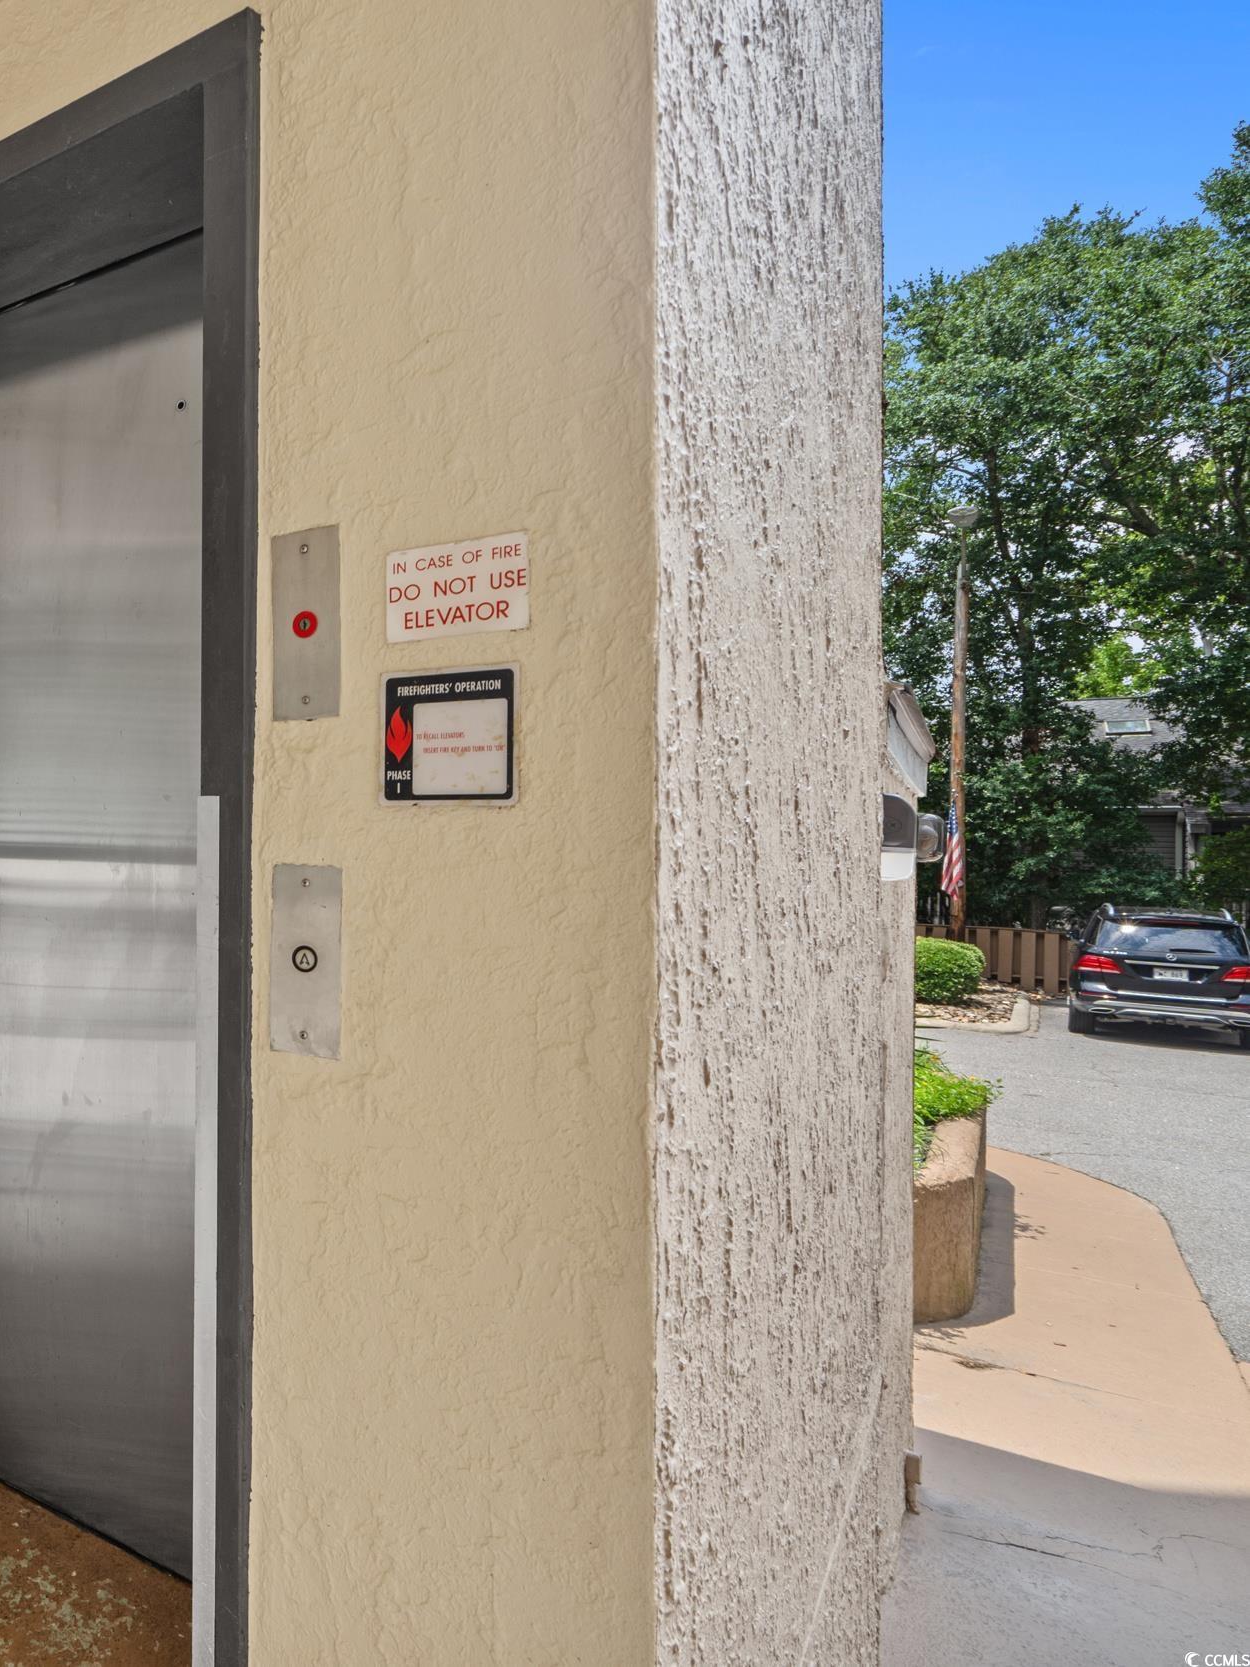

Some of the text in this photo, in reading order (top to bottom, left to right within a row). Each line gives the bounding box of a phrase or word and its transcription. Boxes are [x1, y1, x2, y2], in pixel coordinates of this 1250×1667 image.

[392, 543, 522, 575] IN CASE OF FIRE
[389, 568, 527, 603] DO NOT USE
[404, 600, 509, 630] ELEVATOR
[397, 679, 502, 697] FIREFIGHTERS' OPERATION
[386, 770, 412, 780] PHASE
